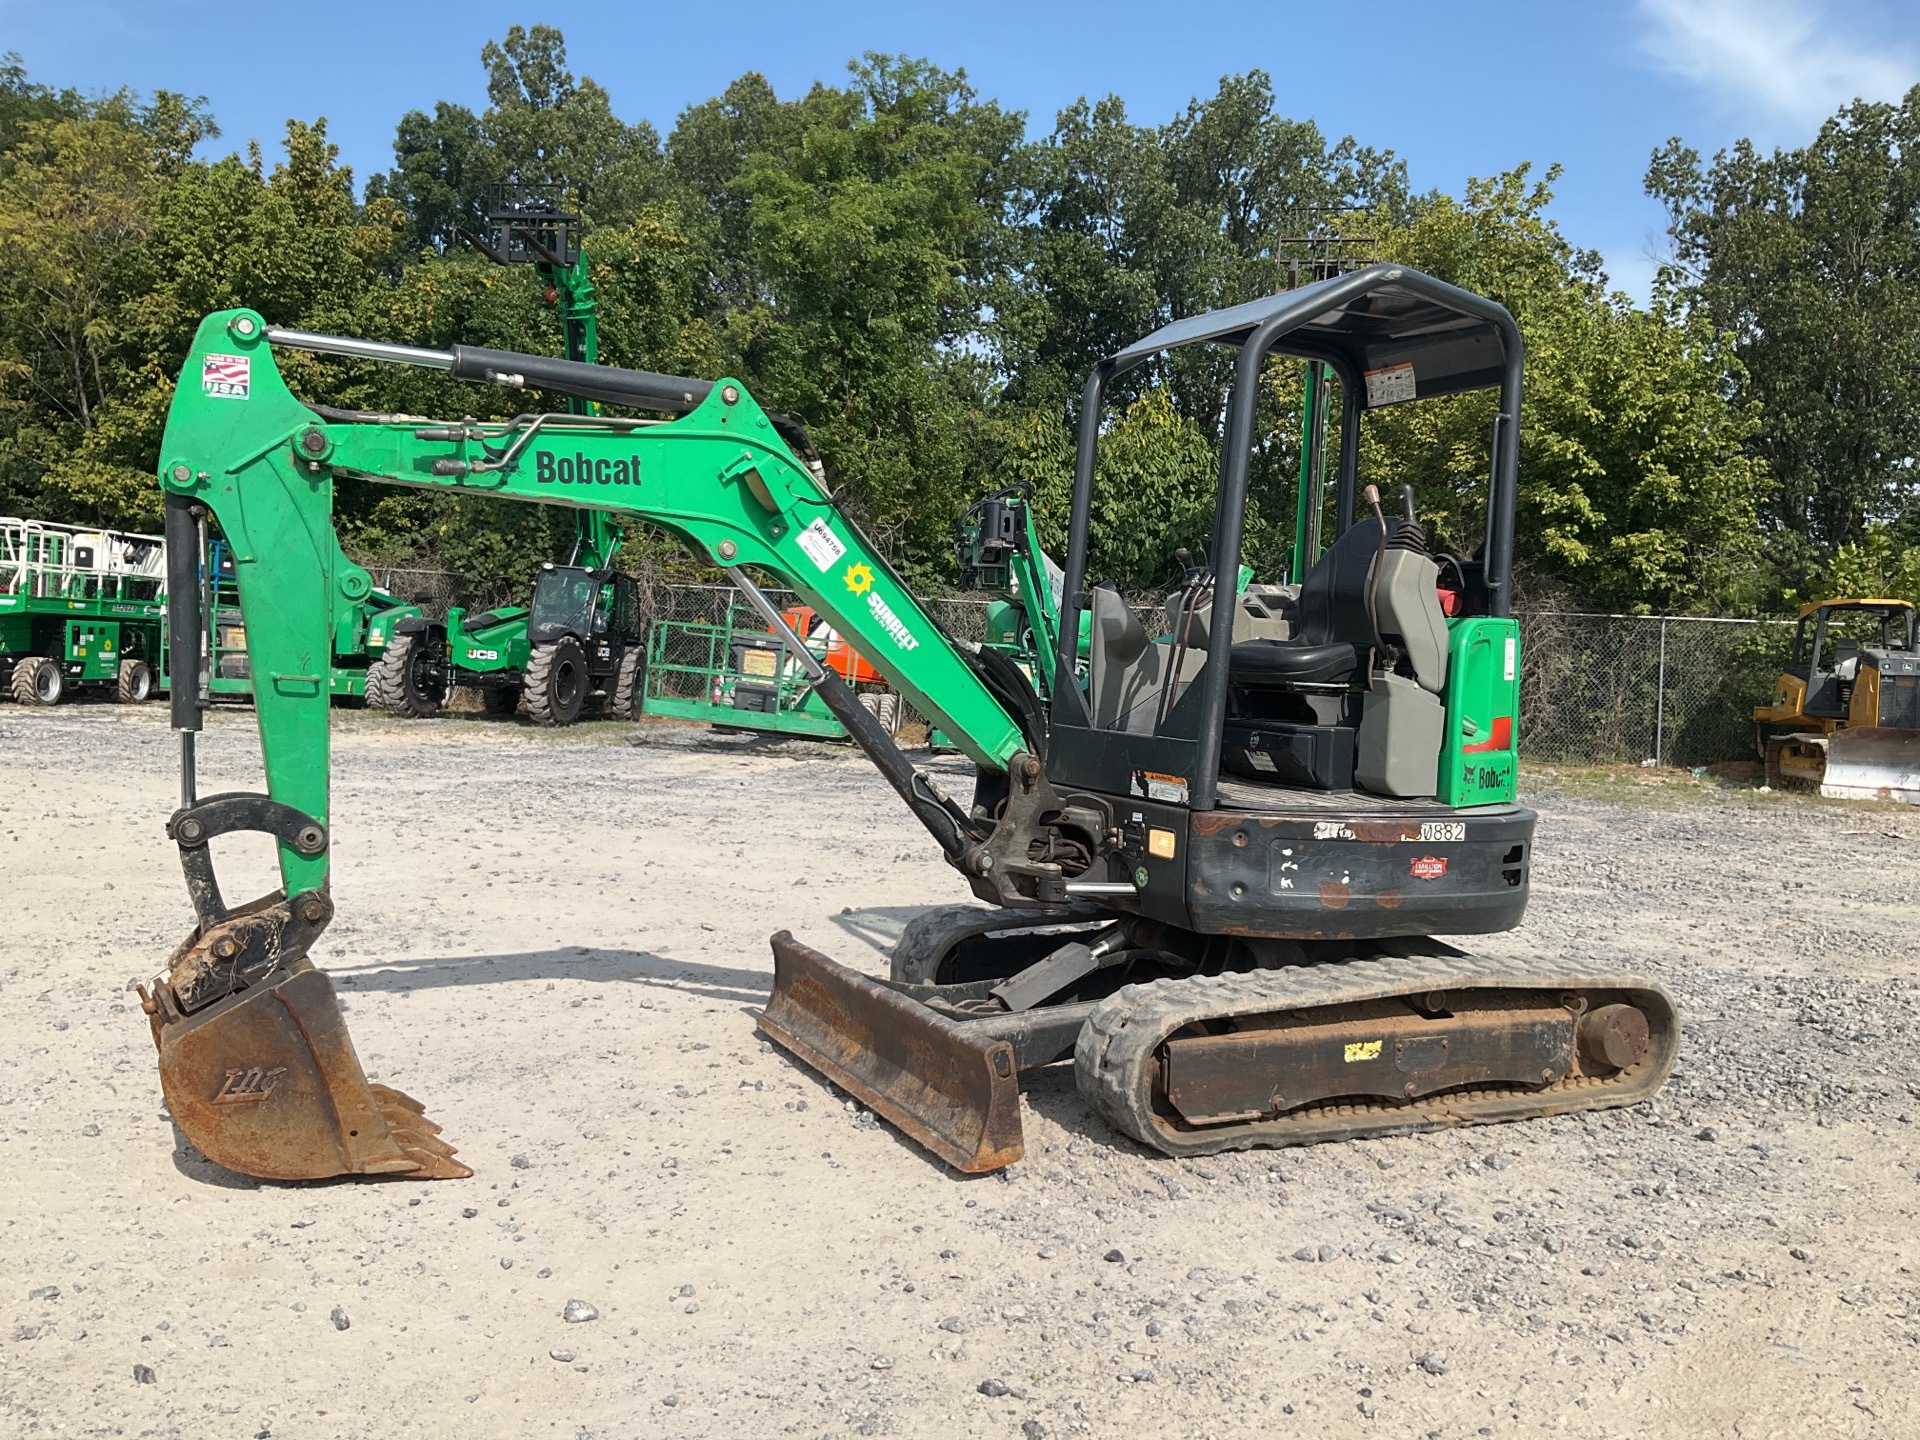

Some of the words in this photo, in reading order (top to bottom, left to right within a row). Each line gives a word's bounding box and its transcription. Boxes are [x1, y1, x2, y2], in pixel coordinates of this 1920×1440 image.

[205, 382, 246, 395] USA
[536, 451, 641, 486] Bobcat
[867, 591, 919, 651] SUNBELT
[468, 649, 498, 660] JCB
[598, 647, 610, 656] JCB
